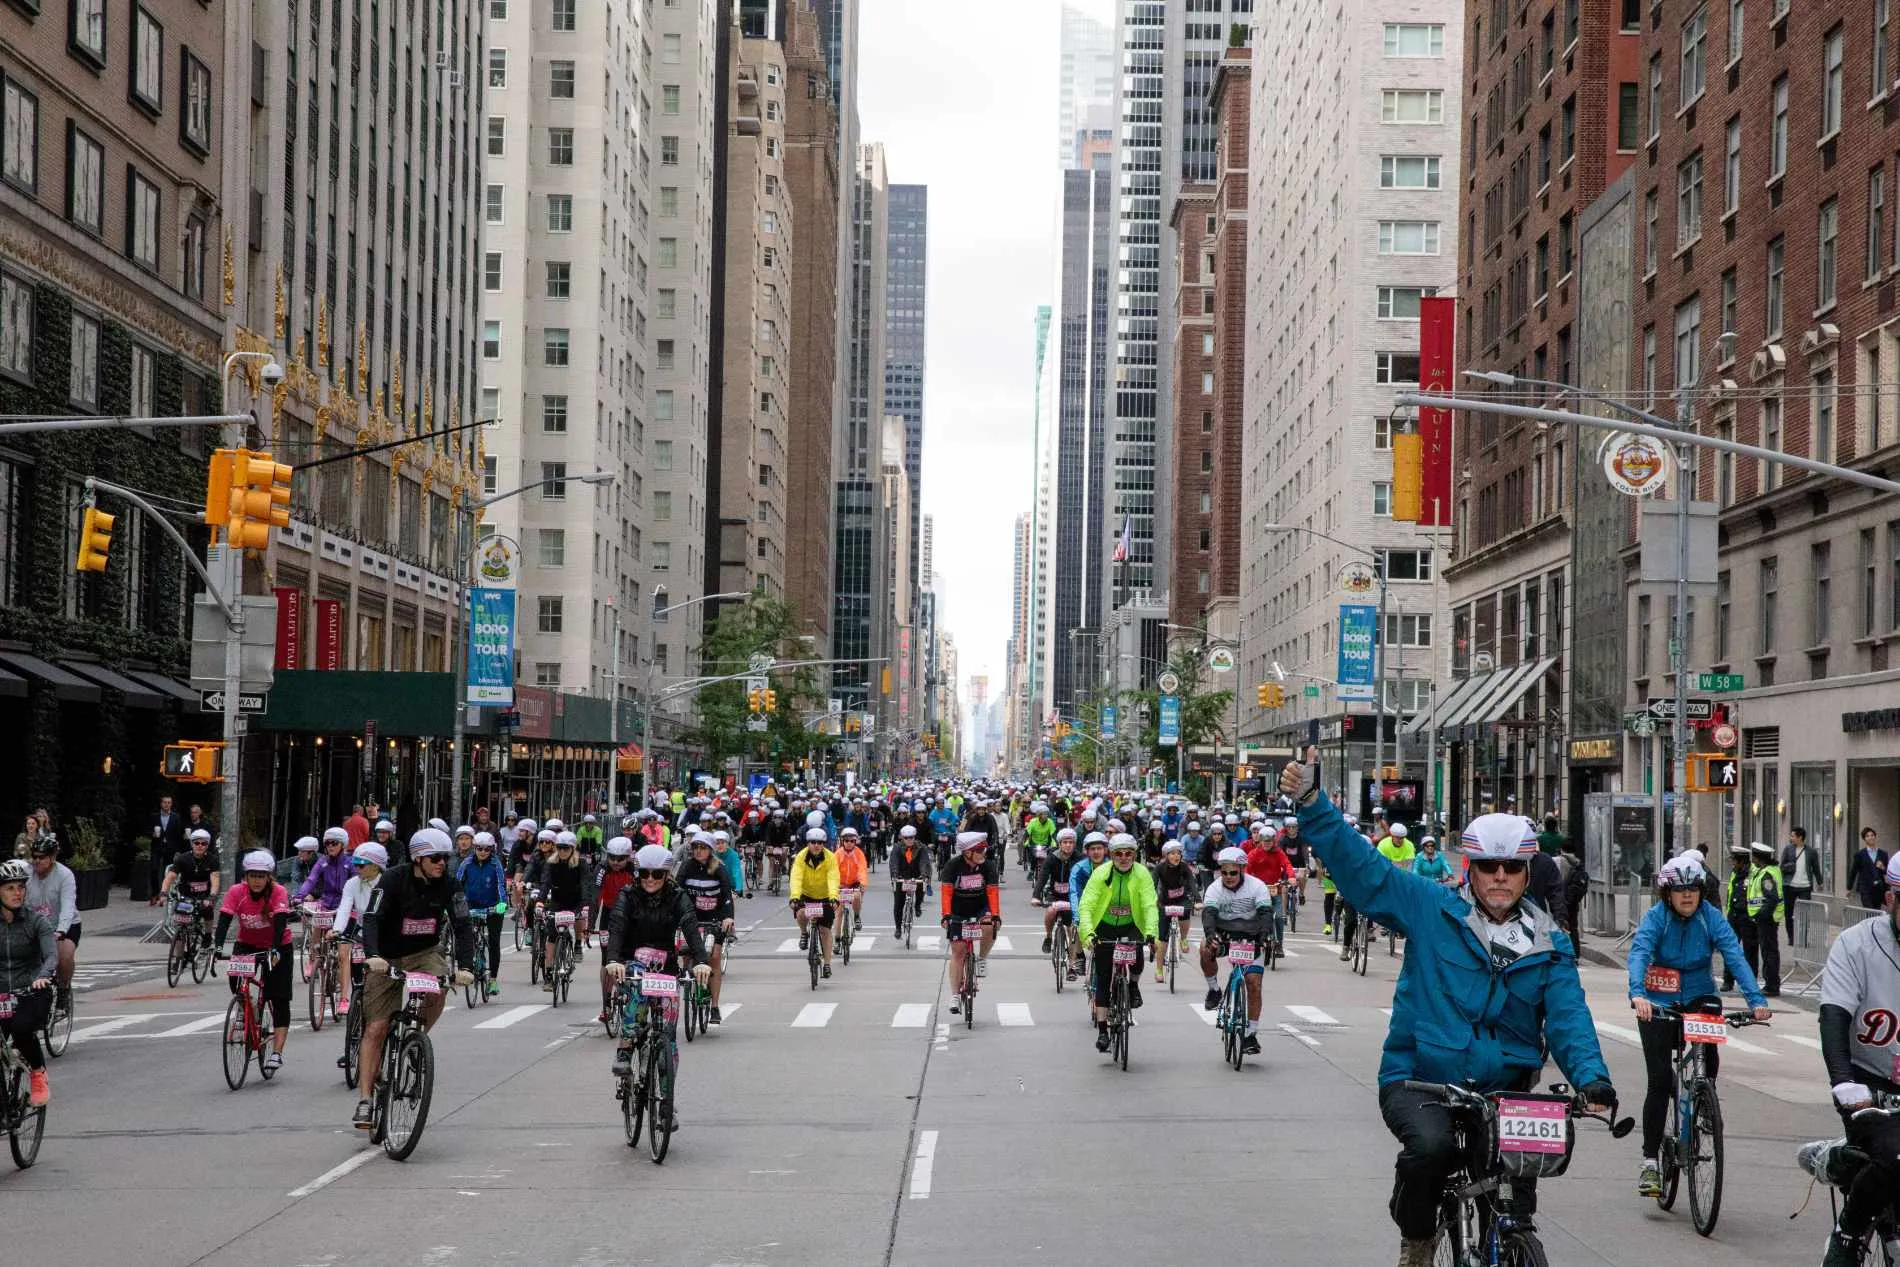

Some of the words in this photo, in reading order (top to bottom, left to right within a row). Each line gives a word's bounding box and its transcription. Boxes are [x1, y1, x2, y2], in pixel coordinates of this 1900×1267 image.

[1615, 481, 1640, 494] COSTA
[1642, 481, 1660, 492] RICA
[287, 592, 297, 639] QUALITY
[328, 604, 338, 646] QUALITY
[474, 624, 509, 634] BORO
[1343, 634, 1371, 642] BORO
[474, 644, 508, 655] TOUR
[1343, 651, 1370, 659] TOUR
[1702, 676, 1712, 688] W
[1716, 676, 1730, 688] 58
[211, 696, 224, 705] ON
[240, 698, 258, 706] WAY
[1655, 704, 1675, 713] ONE
[1686, 704, 1706, 713] WAY
[1646, 974, 1678, 988] 31513
[1687, 1022, 1725, 1035] 31513
[1856, 1007, 1900, 1048] D
[1505, 1119, 1561, 1138] 12161
